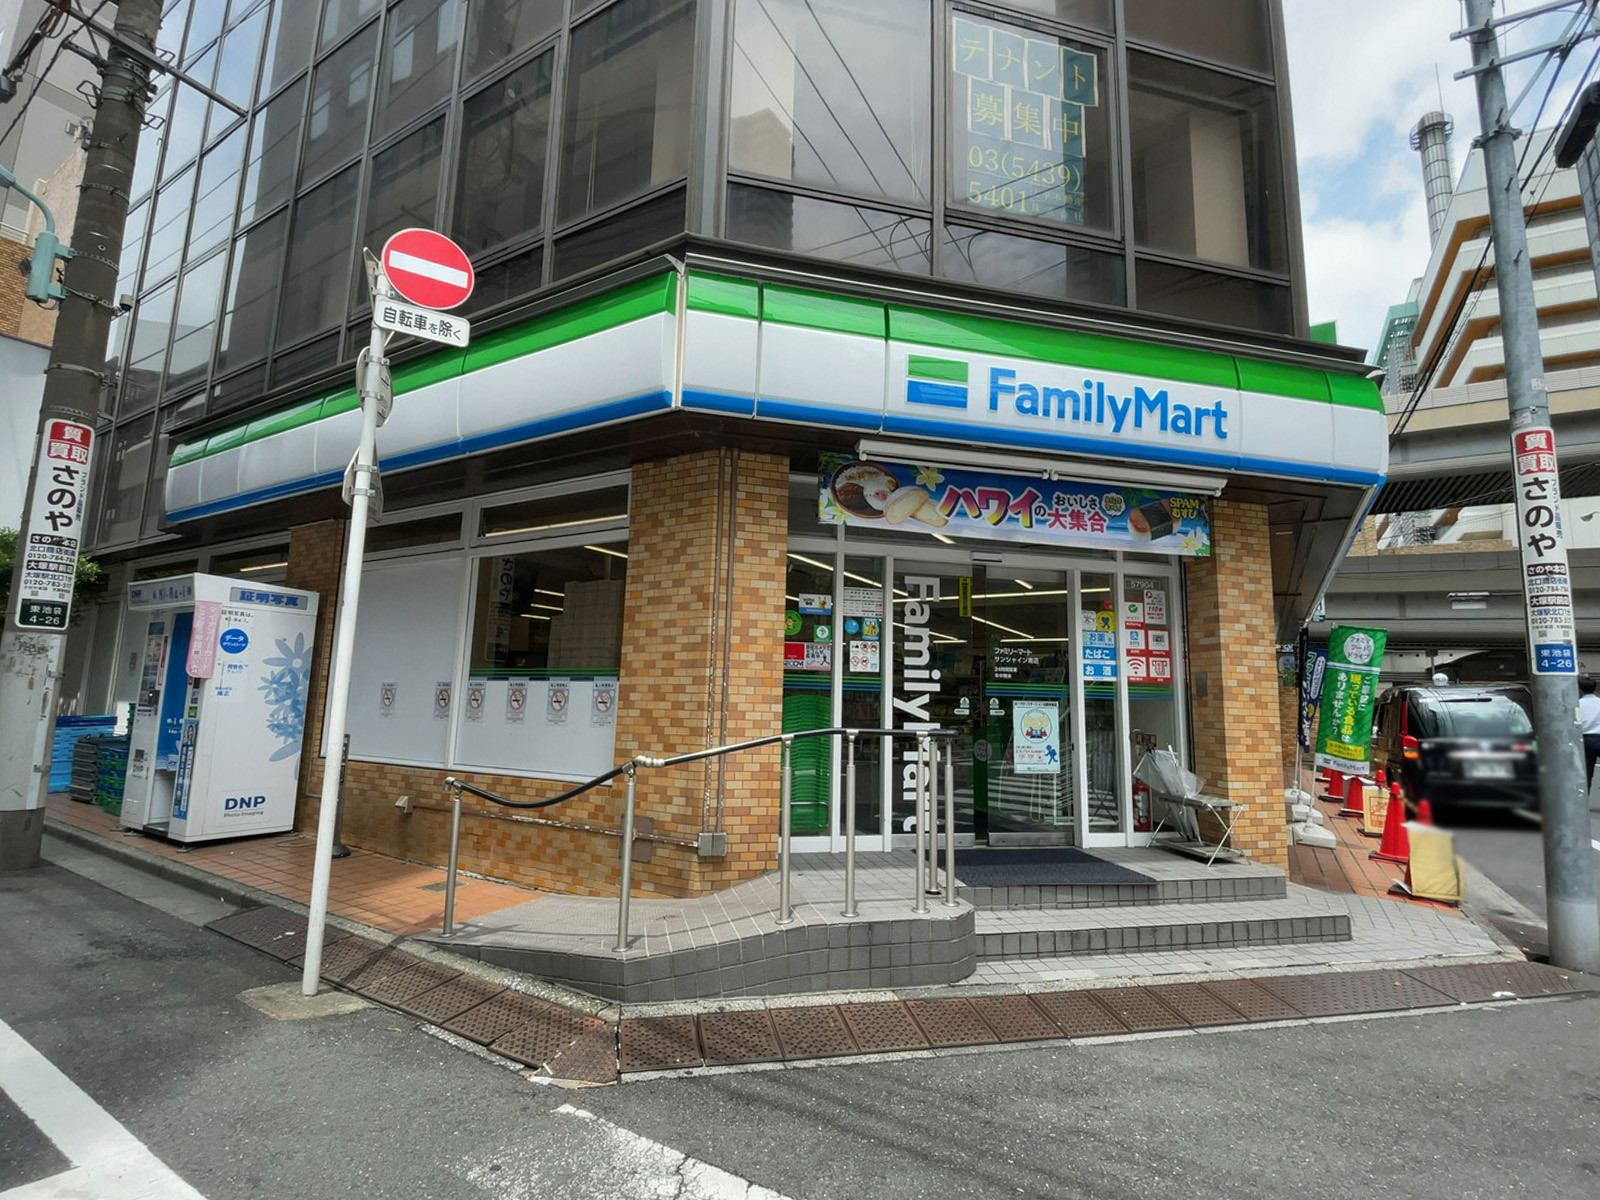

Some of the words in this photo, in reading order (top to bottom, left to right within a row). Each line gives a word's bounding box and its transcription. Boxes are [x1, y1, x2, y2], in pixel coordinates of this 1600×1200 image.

[959, 38, 1086, 90] テナント
[973, 93, 1078, 143] 募集中
[383, 306, 461, 341] 自転車を除く
[988, 366, 1228, 440] FamilyMart
[1518, 453, 1555, 474] 買取
[45, 465, 79, 532] さのや
[1054, 494, 1099, 510] おいしさ
[1169, 497, 1200, 509] SPAM
[1047, 507, 1108, 533] 大集合
[1522, 476, 1557, 557] さのや
[240, 590, 299, 607] 証明写真
[30, 604, 62, 615] 東池袋
[29, 615, 60, 625] 4-26
[994, 647, 1033, 656] ファミリーマート
[1084, 650, 1111, 659] たばこ
[1541, 648, 1571, 658] 東池袋
[1541, 659, 1573, 668] 4-26
[224, 795, 266, 811] DNP
